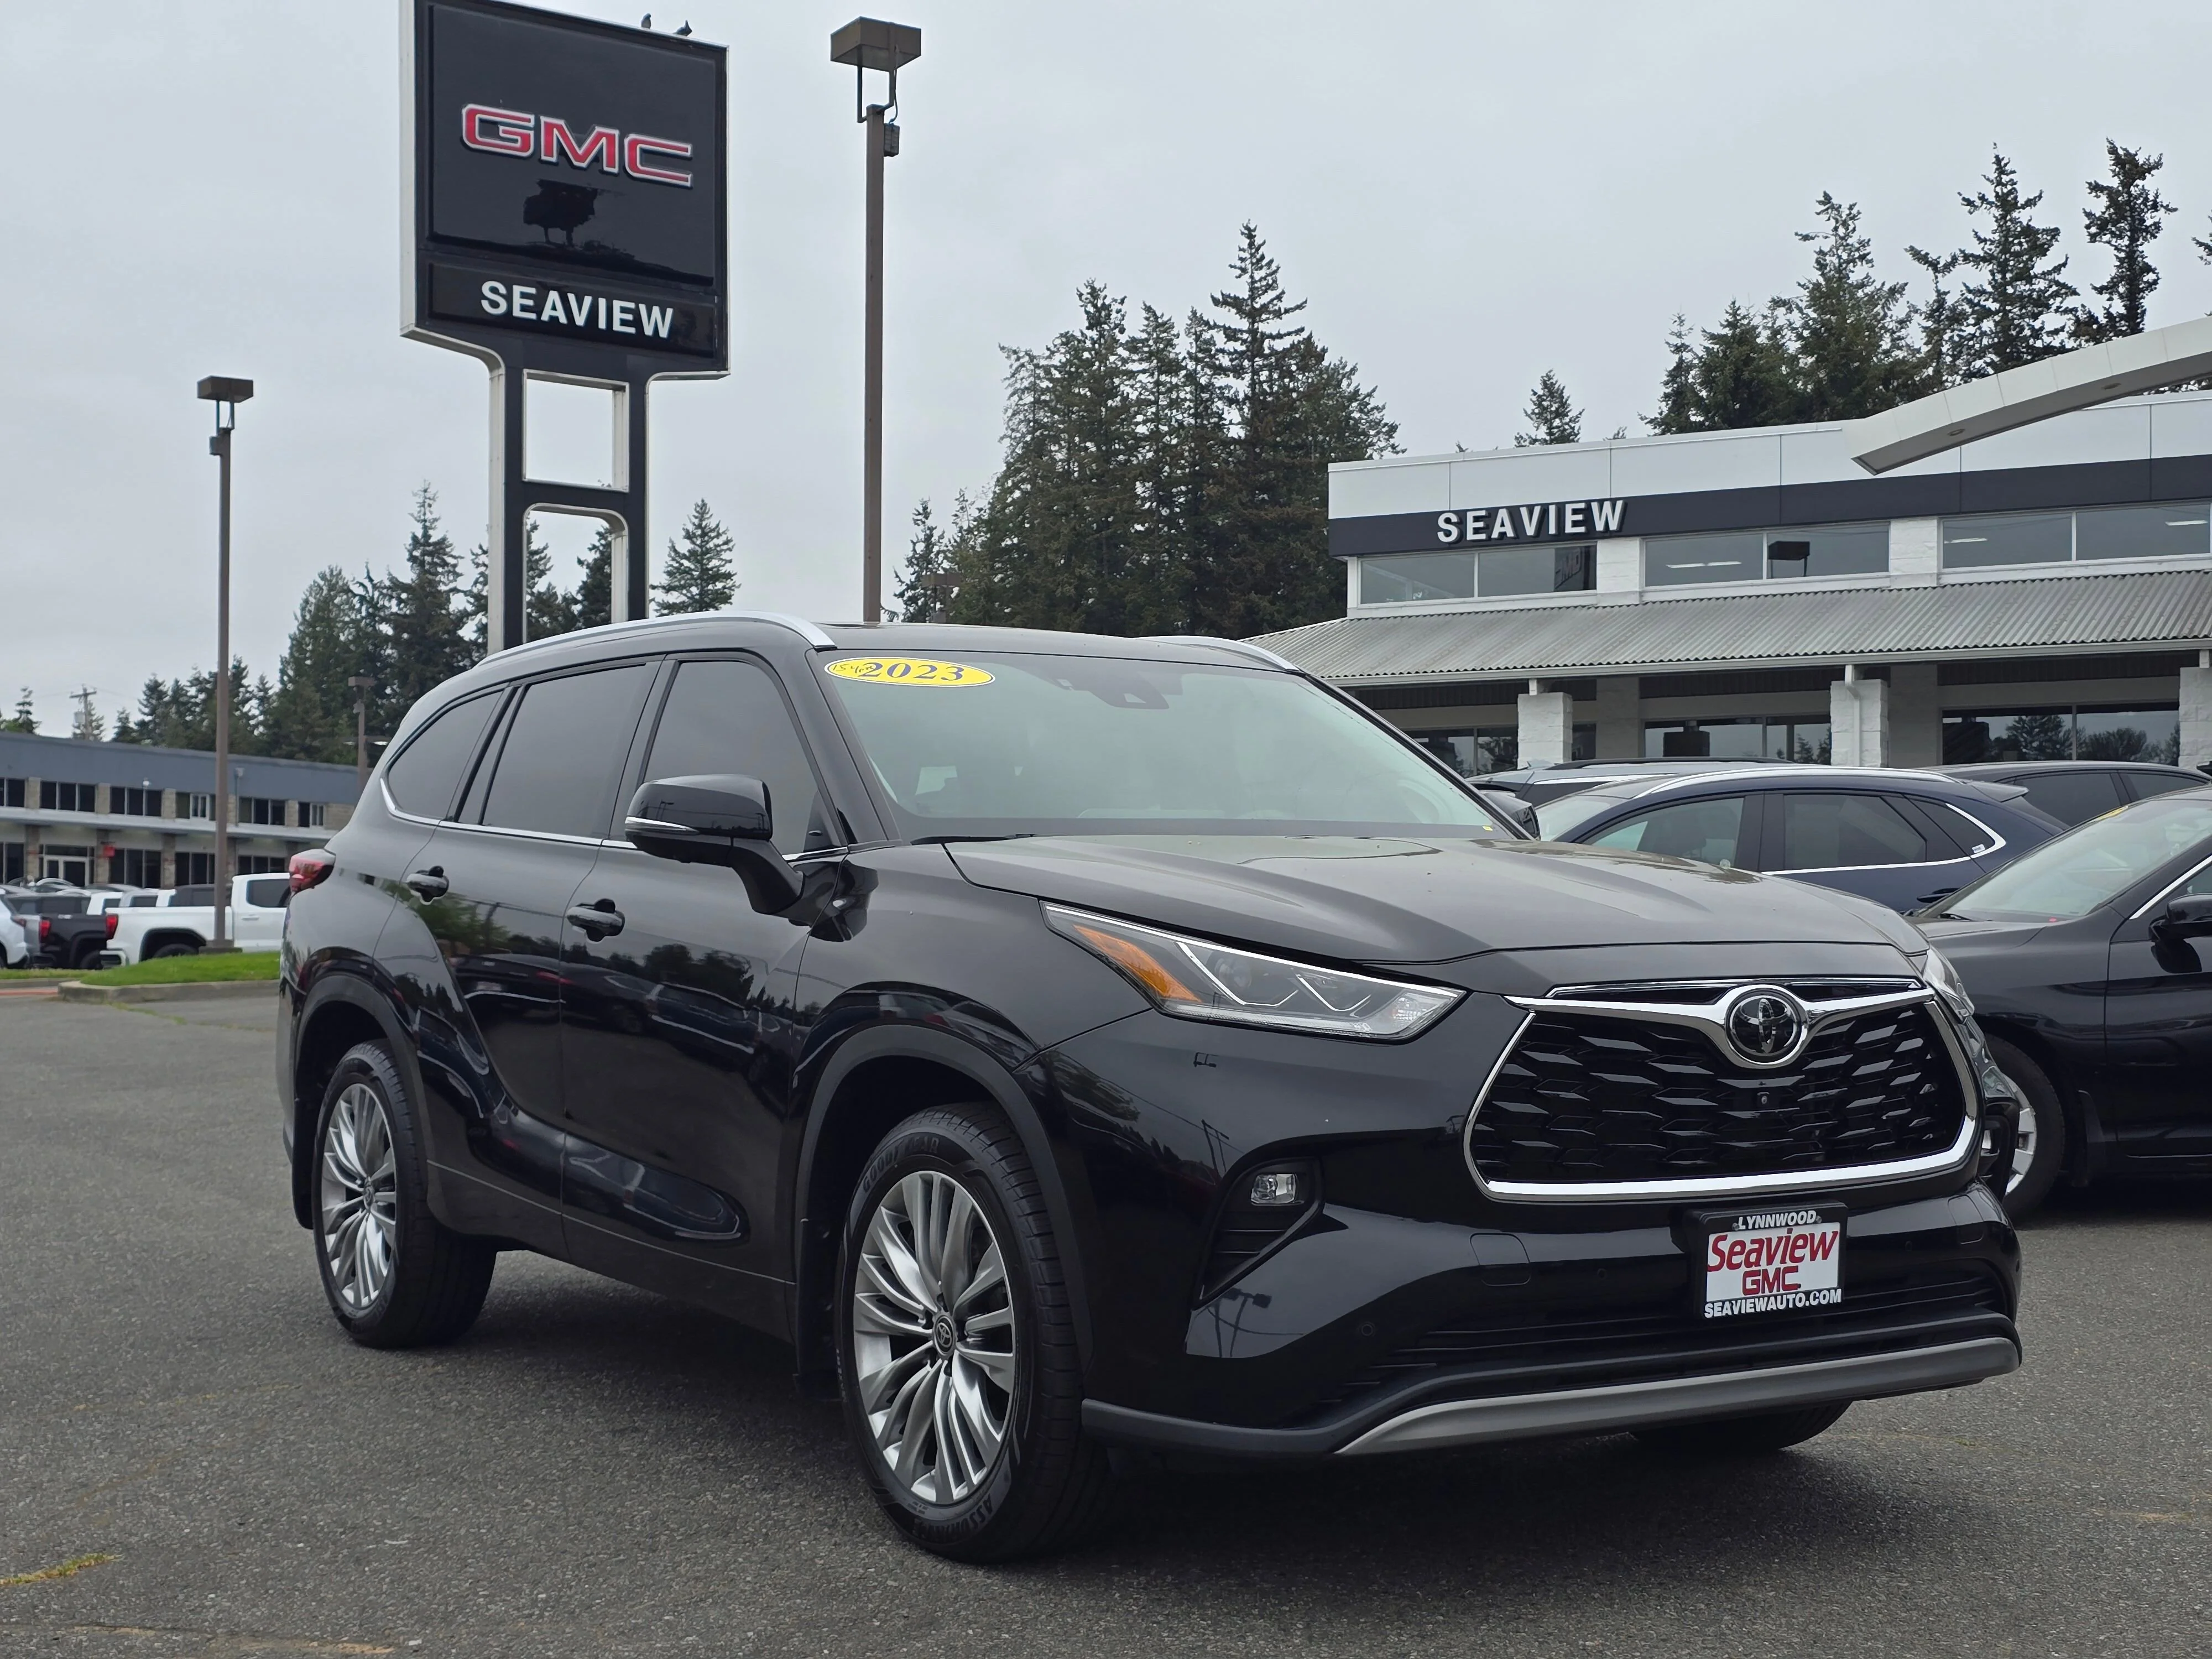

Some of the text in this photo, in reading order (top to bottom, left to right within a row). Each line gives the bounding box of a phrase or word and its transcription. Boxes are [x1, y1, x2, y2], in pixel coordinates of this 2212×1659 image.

[462, 103, 692, 188] GMC
[481, 281, 674, 338] SEAVIEW
[1437, 500, 1626, 544] SEAVIEW
[857, 662, 964, 681] 2023
[1738, 1210, 1817, 1230] LYNNWOOD
[1707, 1228, 1839, 1272] Seaview
[1742, 1265, 1802, 1296] GMC
[1704, 1288, 1842, 1319] SEAVIEWAUTO.COM
